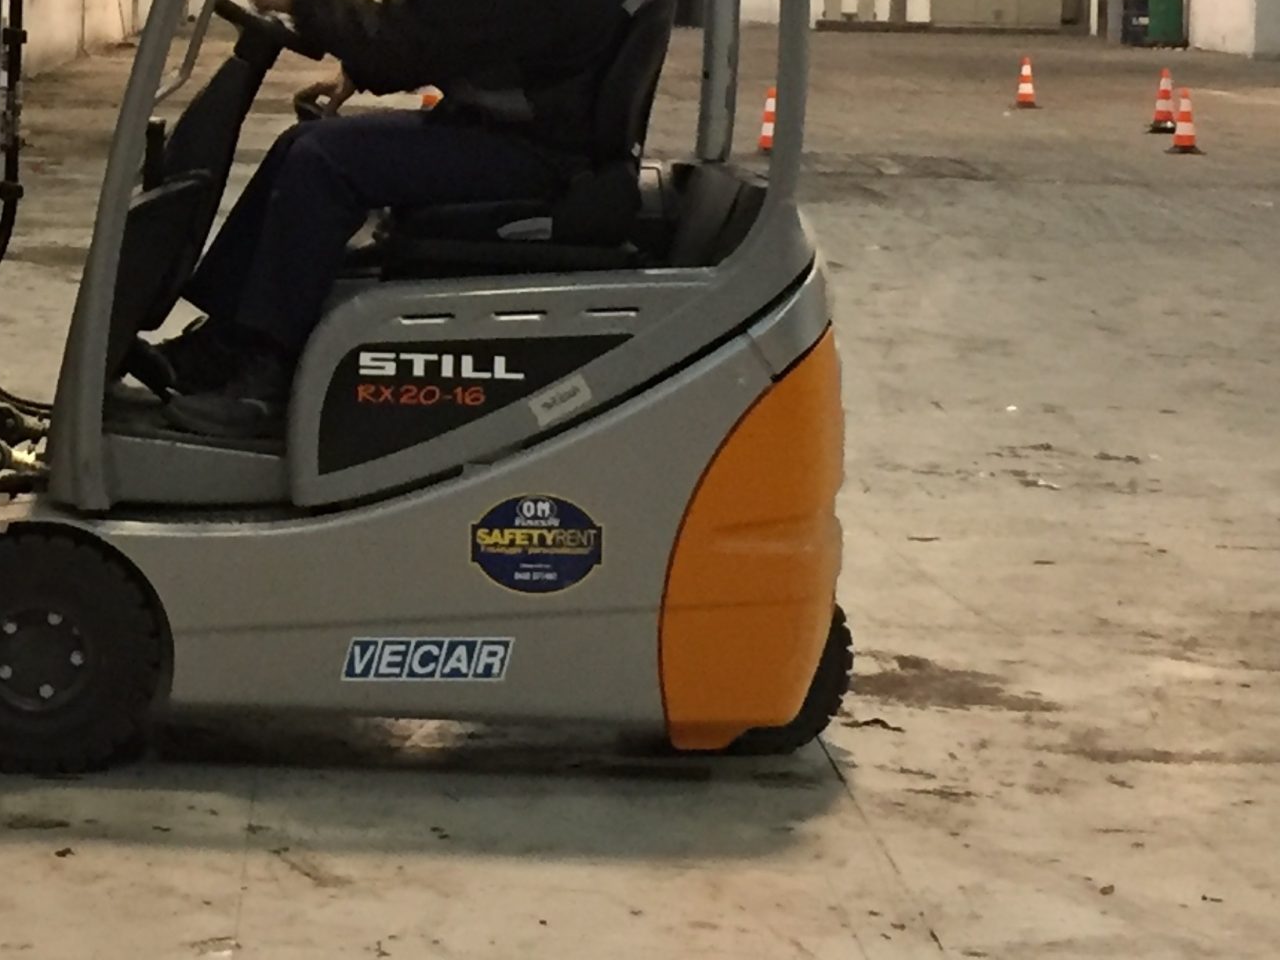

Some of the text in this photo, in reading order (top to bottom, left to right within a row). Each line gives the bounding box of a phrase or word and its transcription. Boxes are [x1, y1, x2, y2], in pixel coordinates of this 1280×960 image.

[358, 351, 525, 380] STILL
[522, 500, 551, 518] OM
[351, 644, 506, 675] VECAR
